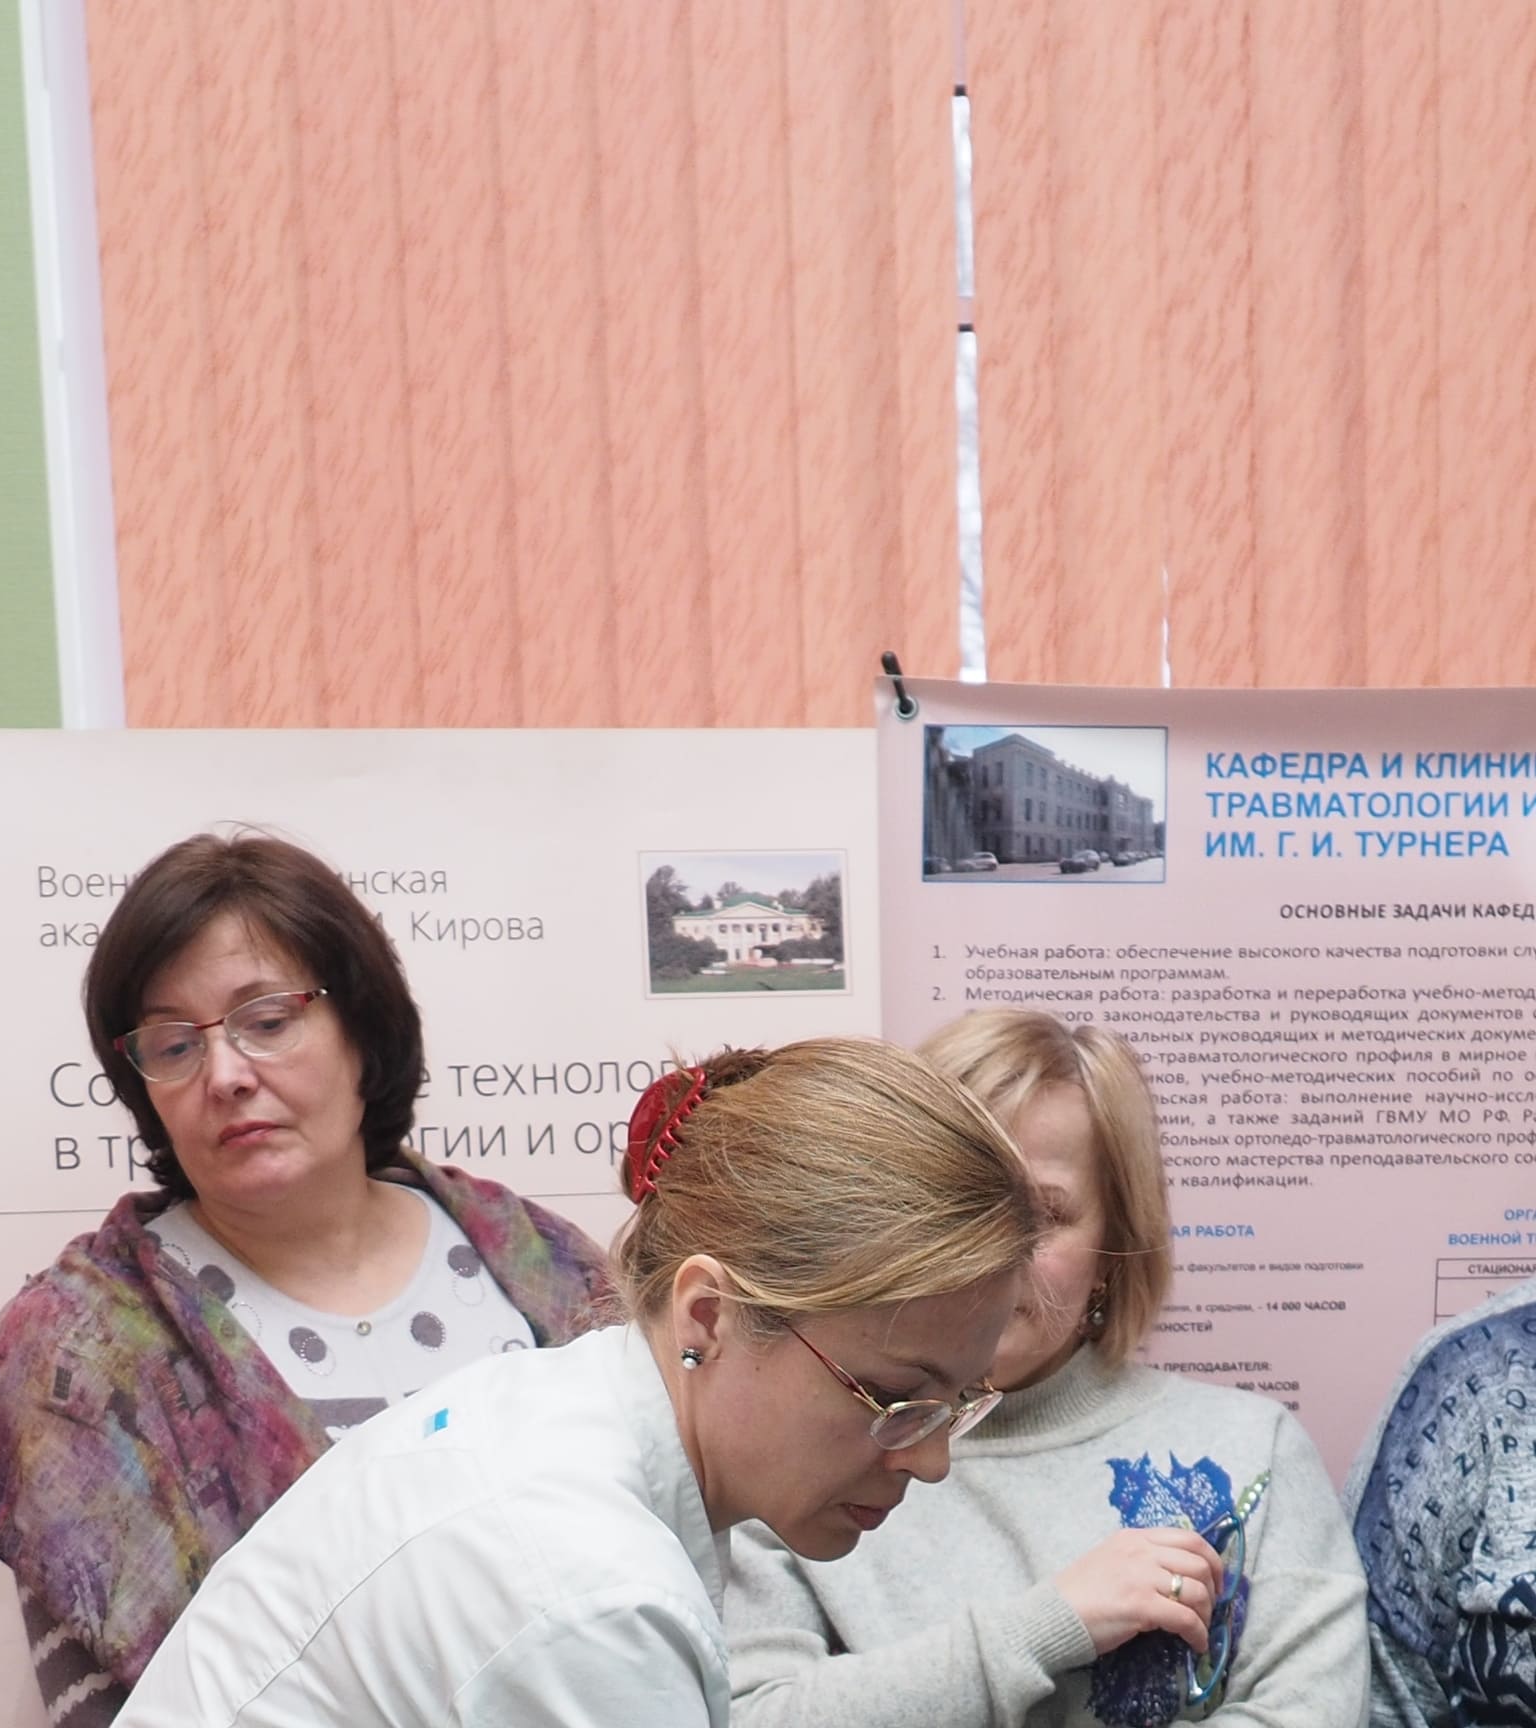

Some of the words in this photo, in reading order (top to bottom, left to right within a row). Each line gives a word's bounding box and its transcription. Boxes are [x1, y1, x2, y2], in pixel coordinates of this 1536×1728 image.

[1205, 751, 1370, 784] КАФЕДРА
[1381, 752, 1402, 778] И
[1205, 791, 1510, 819] ТРАВМАТОЛОГИИ
[1205, 831, 1264, 859] ИМ.
[1278, 832, 1299, 858] Г.
[1311, 831, 1343, 858] И.
[1355, 831, 1511, 858] ТУРНЕРА
[37, 865, 140, 899] Воен
[1279, 903, 1388, 920] ОСНОВНЫЕ
[1392, 902, 1467, 921] ЗАДАЧИ
[411, 910, 545, 950] Кирова
[932, 945, 947, 959] 1.
[965, 944, 1039, 962] Учебная
[1044, 944, 1111, 963] работа:
[1116, 945, 1232, 961] обеспечение
[1238, 945, 1321, 960] высокого
[1326, 945, 1401, 959] качества
[1407, 943, 1508, 961] подготовки
[965, 966, 1116, 981] образовательным
[1119, 968, 1230, 982] программам.
[932, 988, 947, 1000] 2.
[965, 987, 1094, 1003] Методическая
[1098, 987, 1166, 1004] работа:
[1170, 986, 1272, 1004] разработка
[1277, 989, 1288, 1001] и
[1293, 986, 1407, 1004] переработка
[1102, 1009, 1261, 1025] законодательства
[1269, 1010, 1280, 1022] и
[1289, 1009, 1409, 1027] руководящих
[1417, 1007, 1524, 1023] документов
[1199, 1028, 1318, 1046] руководящих
[1323, 1029, 1335, 1042] и
[1340, 1028, 1465, 1044] методических
[1355, 1047, 1433, 1066] профиля
[1441, 1049, 1450, 1062] в
[1458, 1048, 1530, 1065] мирное
[1200, 1068, 1396, 1087] учебно-методических
[1405, 1068, 1481, 1083] пособий
[1491, 1070, 1514, 1083] по
[1220, 1090, 1288, 1108] работа:
[1300, 1091, 1414, 1105] выполнение
[1206, 1114, 1217, 1126] а
[1226, 1112, 1280, 1126] также
[1290, 1108, 1364, 1126] заданий
[1376, 1108, 1427, 1125] ГВМУ
[1438, 1108, 1472, 1124] МО
[1482, 1107, 1511, 1124] РФ.
[54, 1136, 81, 1170] в
[528, 1124, 555, 1156] и
[1159, 1131, 1230, 1147] больных
[1234, 1131, 1492, 1149] ортопедо-травматологического
[1225, 1153, 1324, 1170] мастерства
[1330, 1151, 1508, 1168] преподавательского
[1180, 1173, 1314, 1191] квалификации.
[1195, 1225, 1255, 1238] РАБОТА
[1447, 1232, 1522, 1246] ВОЕННОЙ
[1304, 1301, 1347, 1312] ЧАСОВ
